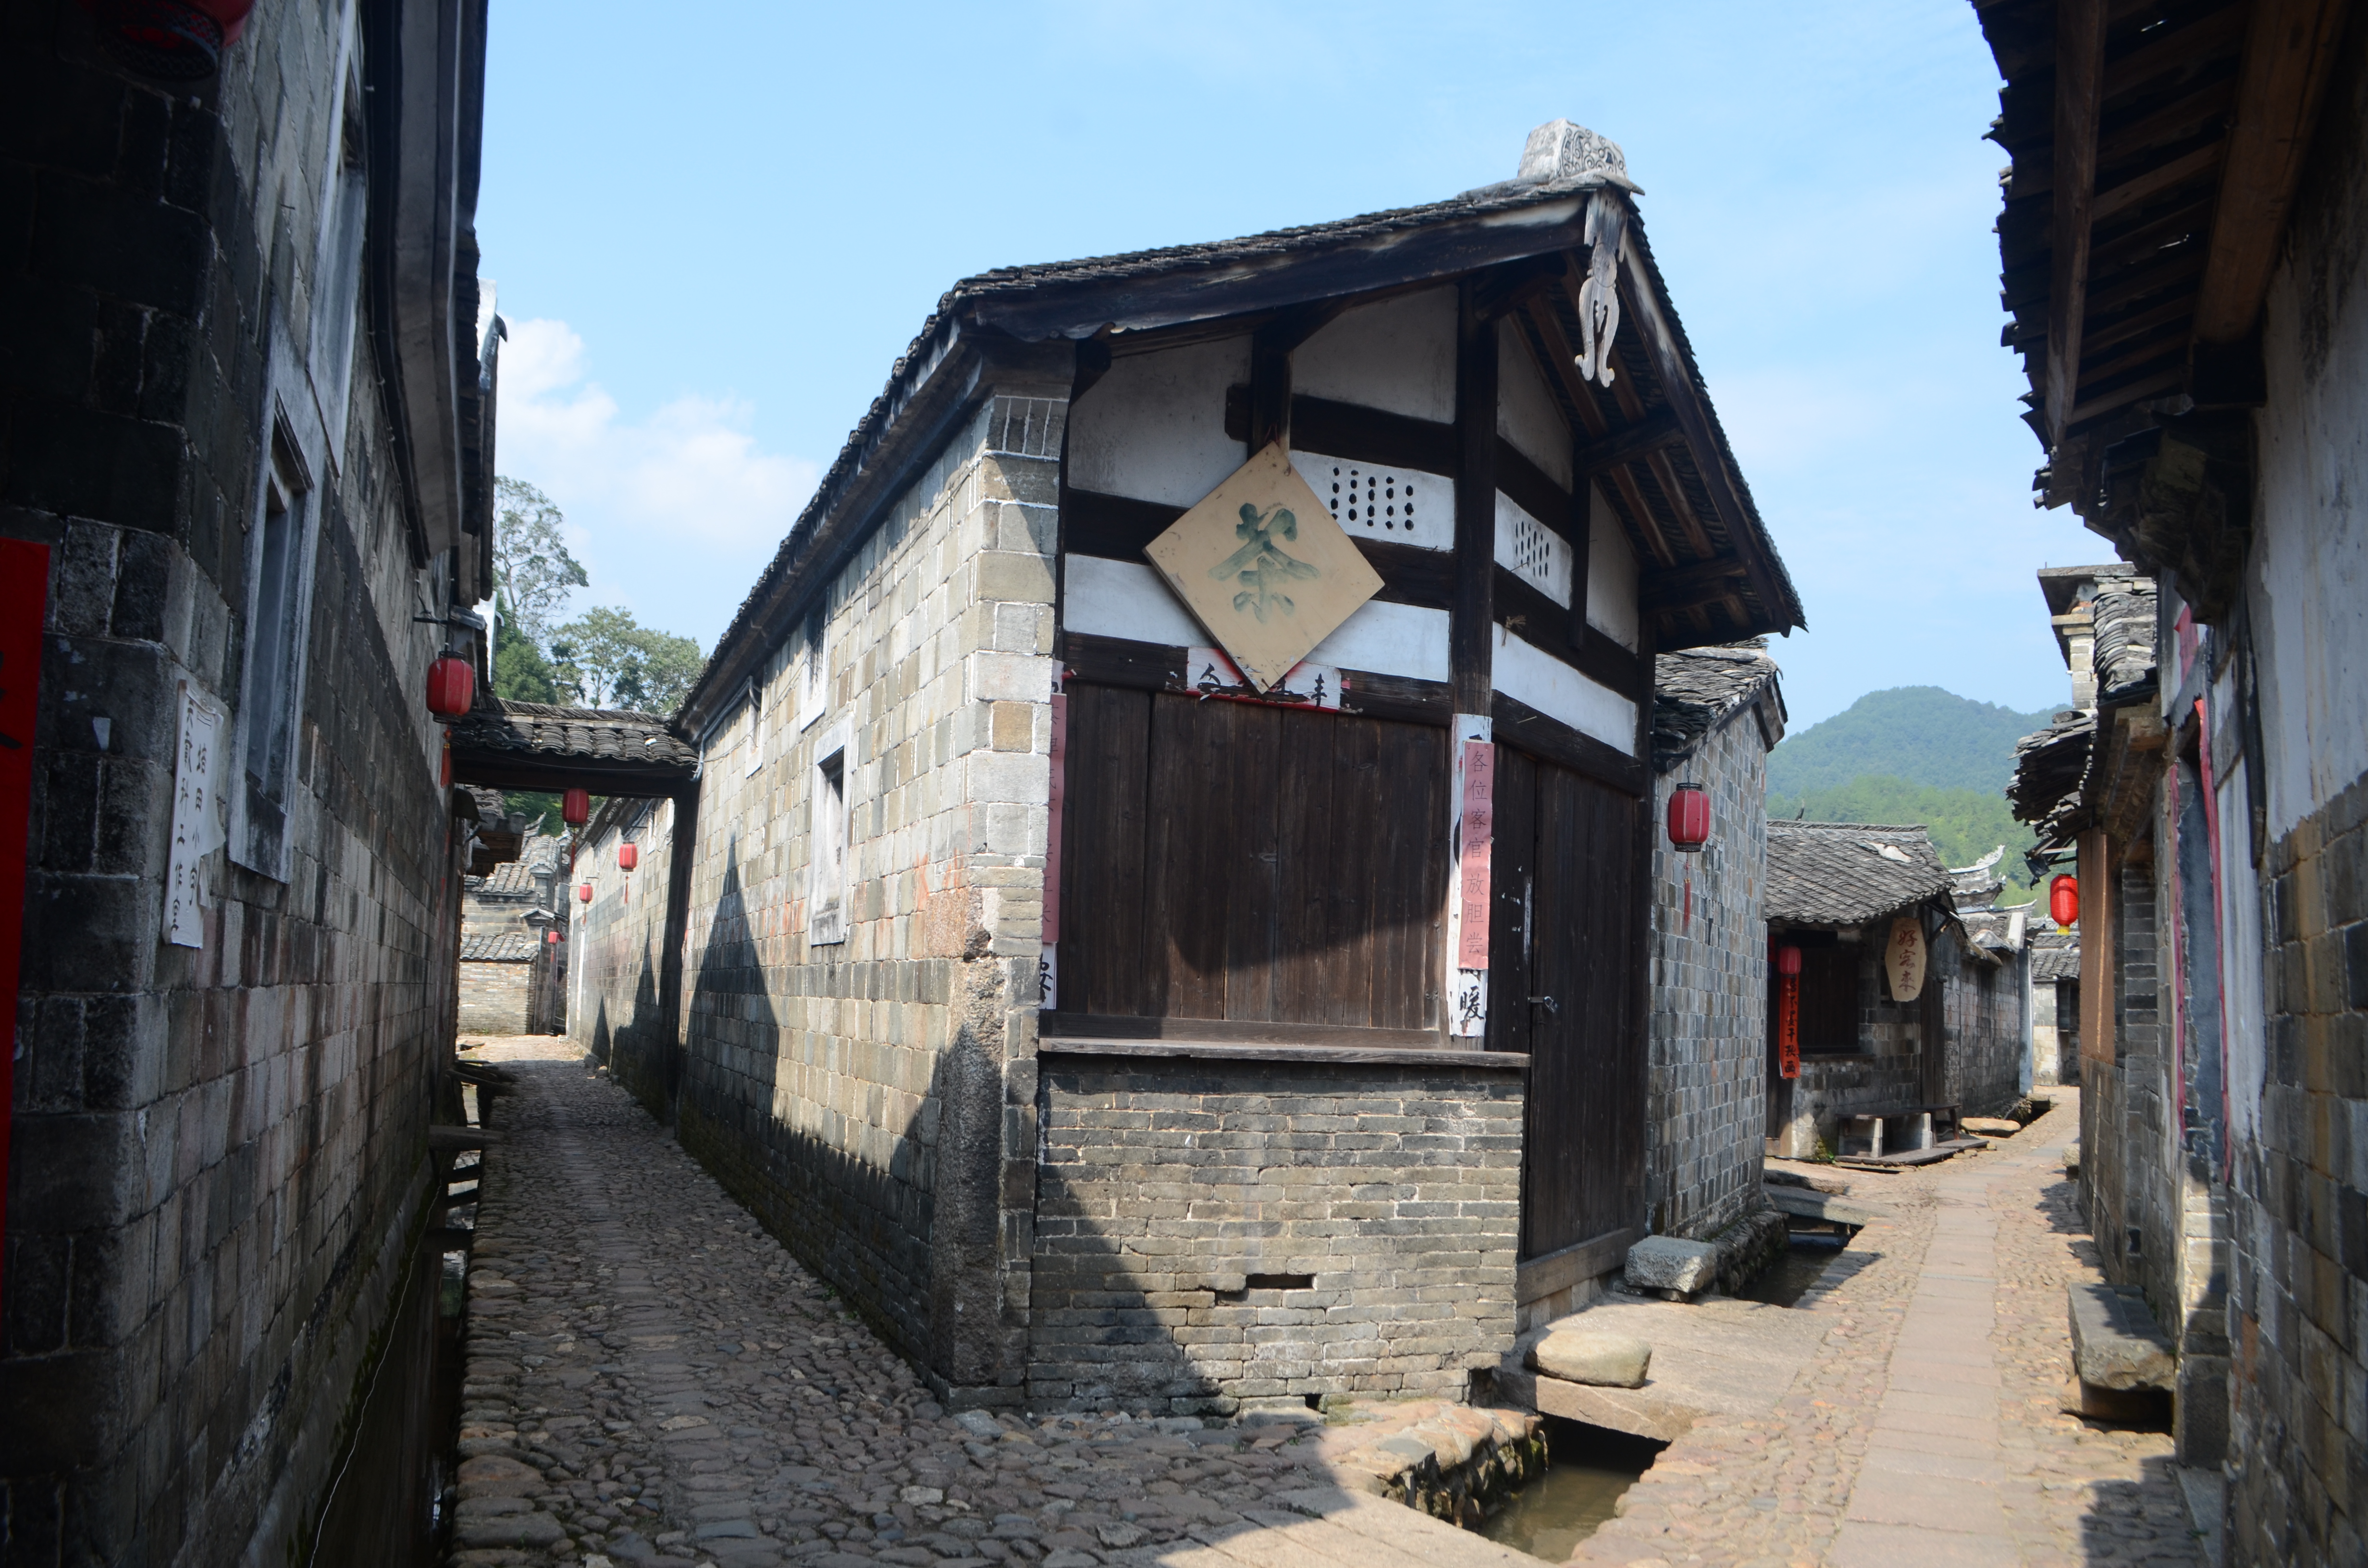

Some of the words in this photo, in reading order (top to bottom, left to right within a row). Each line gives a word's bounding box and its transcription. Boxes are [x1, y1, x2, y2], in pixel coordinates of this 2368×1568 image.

[1208, 502, 1321, 624] 茶
[1465, 750, 1489, 954] 各位客官放胆尝
[1459, 984, 1485, 1020] 暖
